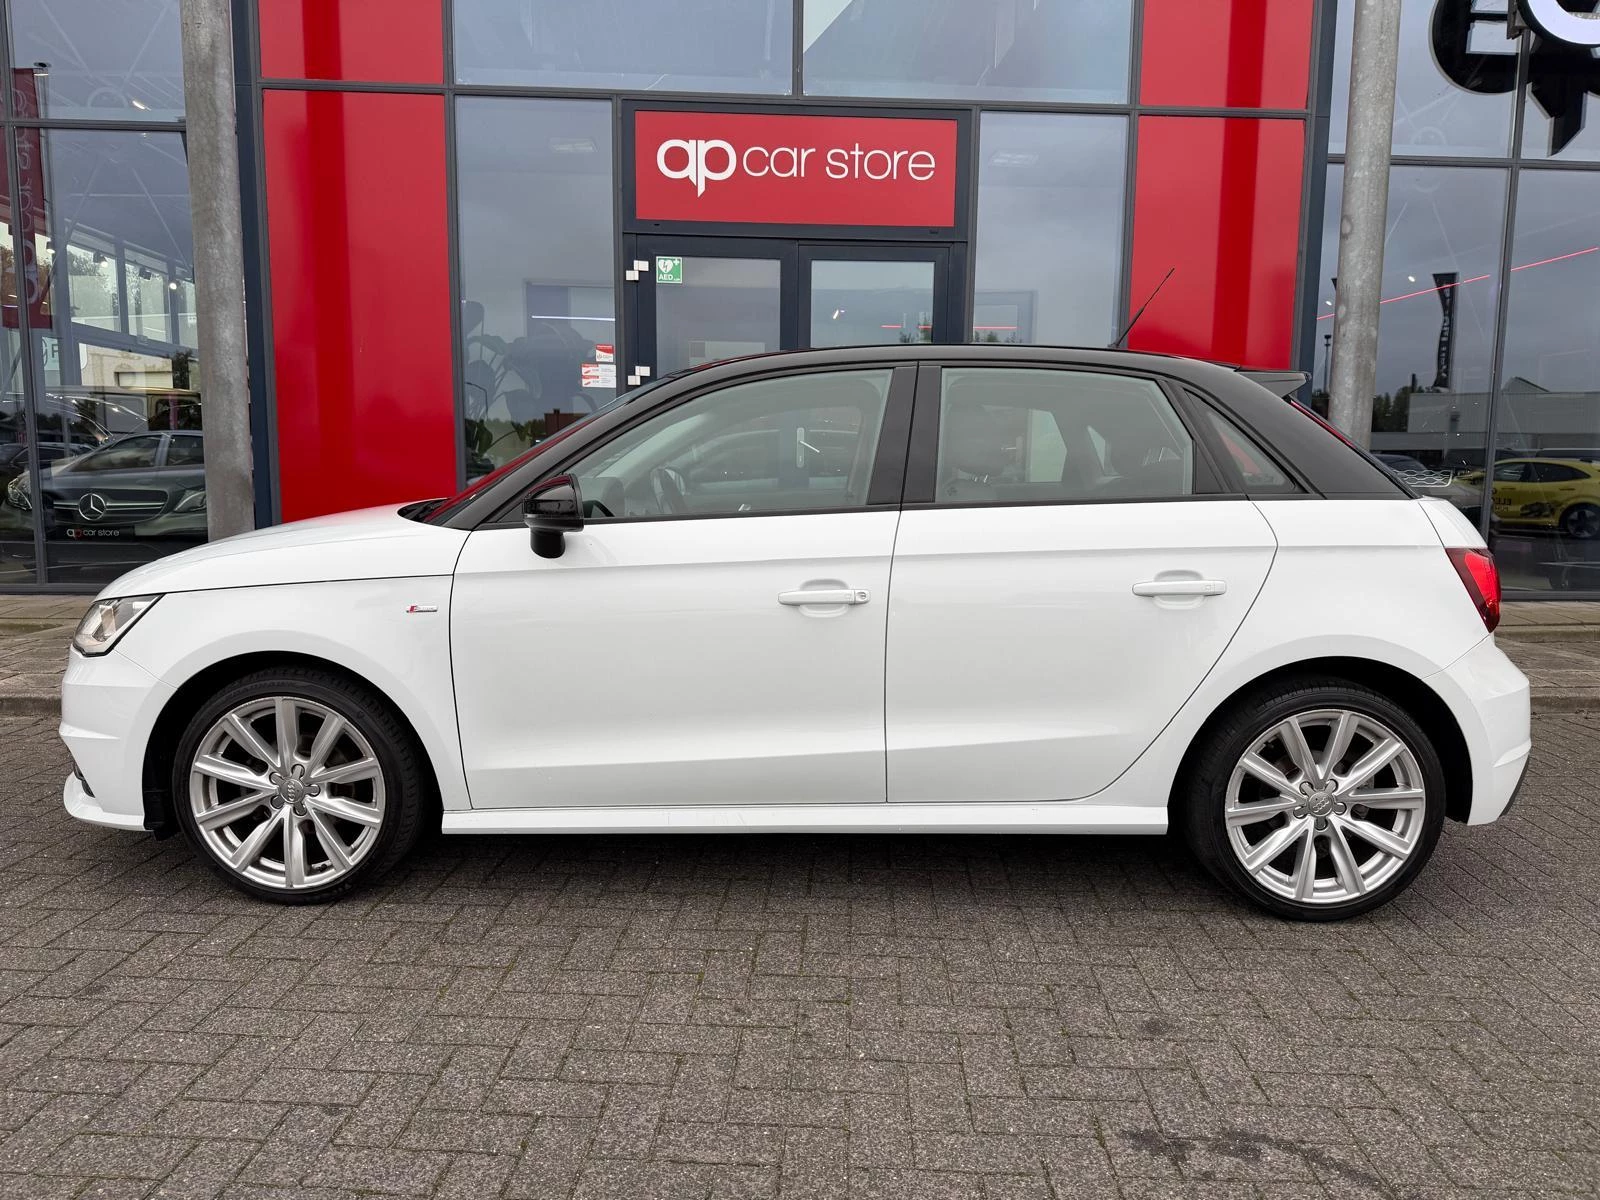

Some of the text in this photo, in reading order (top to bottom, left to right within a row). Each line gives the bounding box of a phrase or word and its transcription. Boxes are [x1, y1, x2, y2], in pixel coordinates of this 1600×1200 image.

[656, 139, 936, 198] ap car store
[658, 273, 674, 281] AED
[98, 529, 120, 537] store
